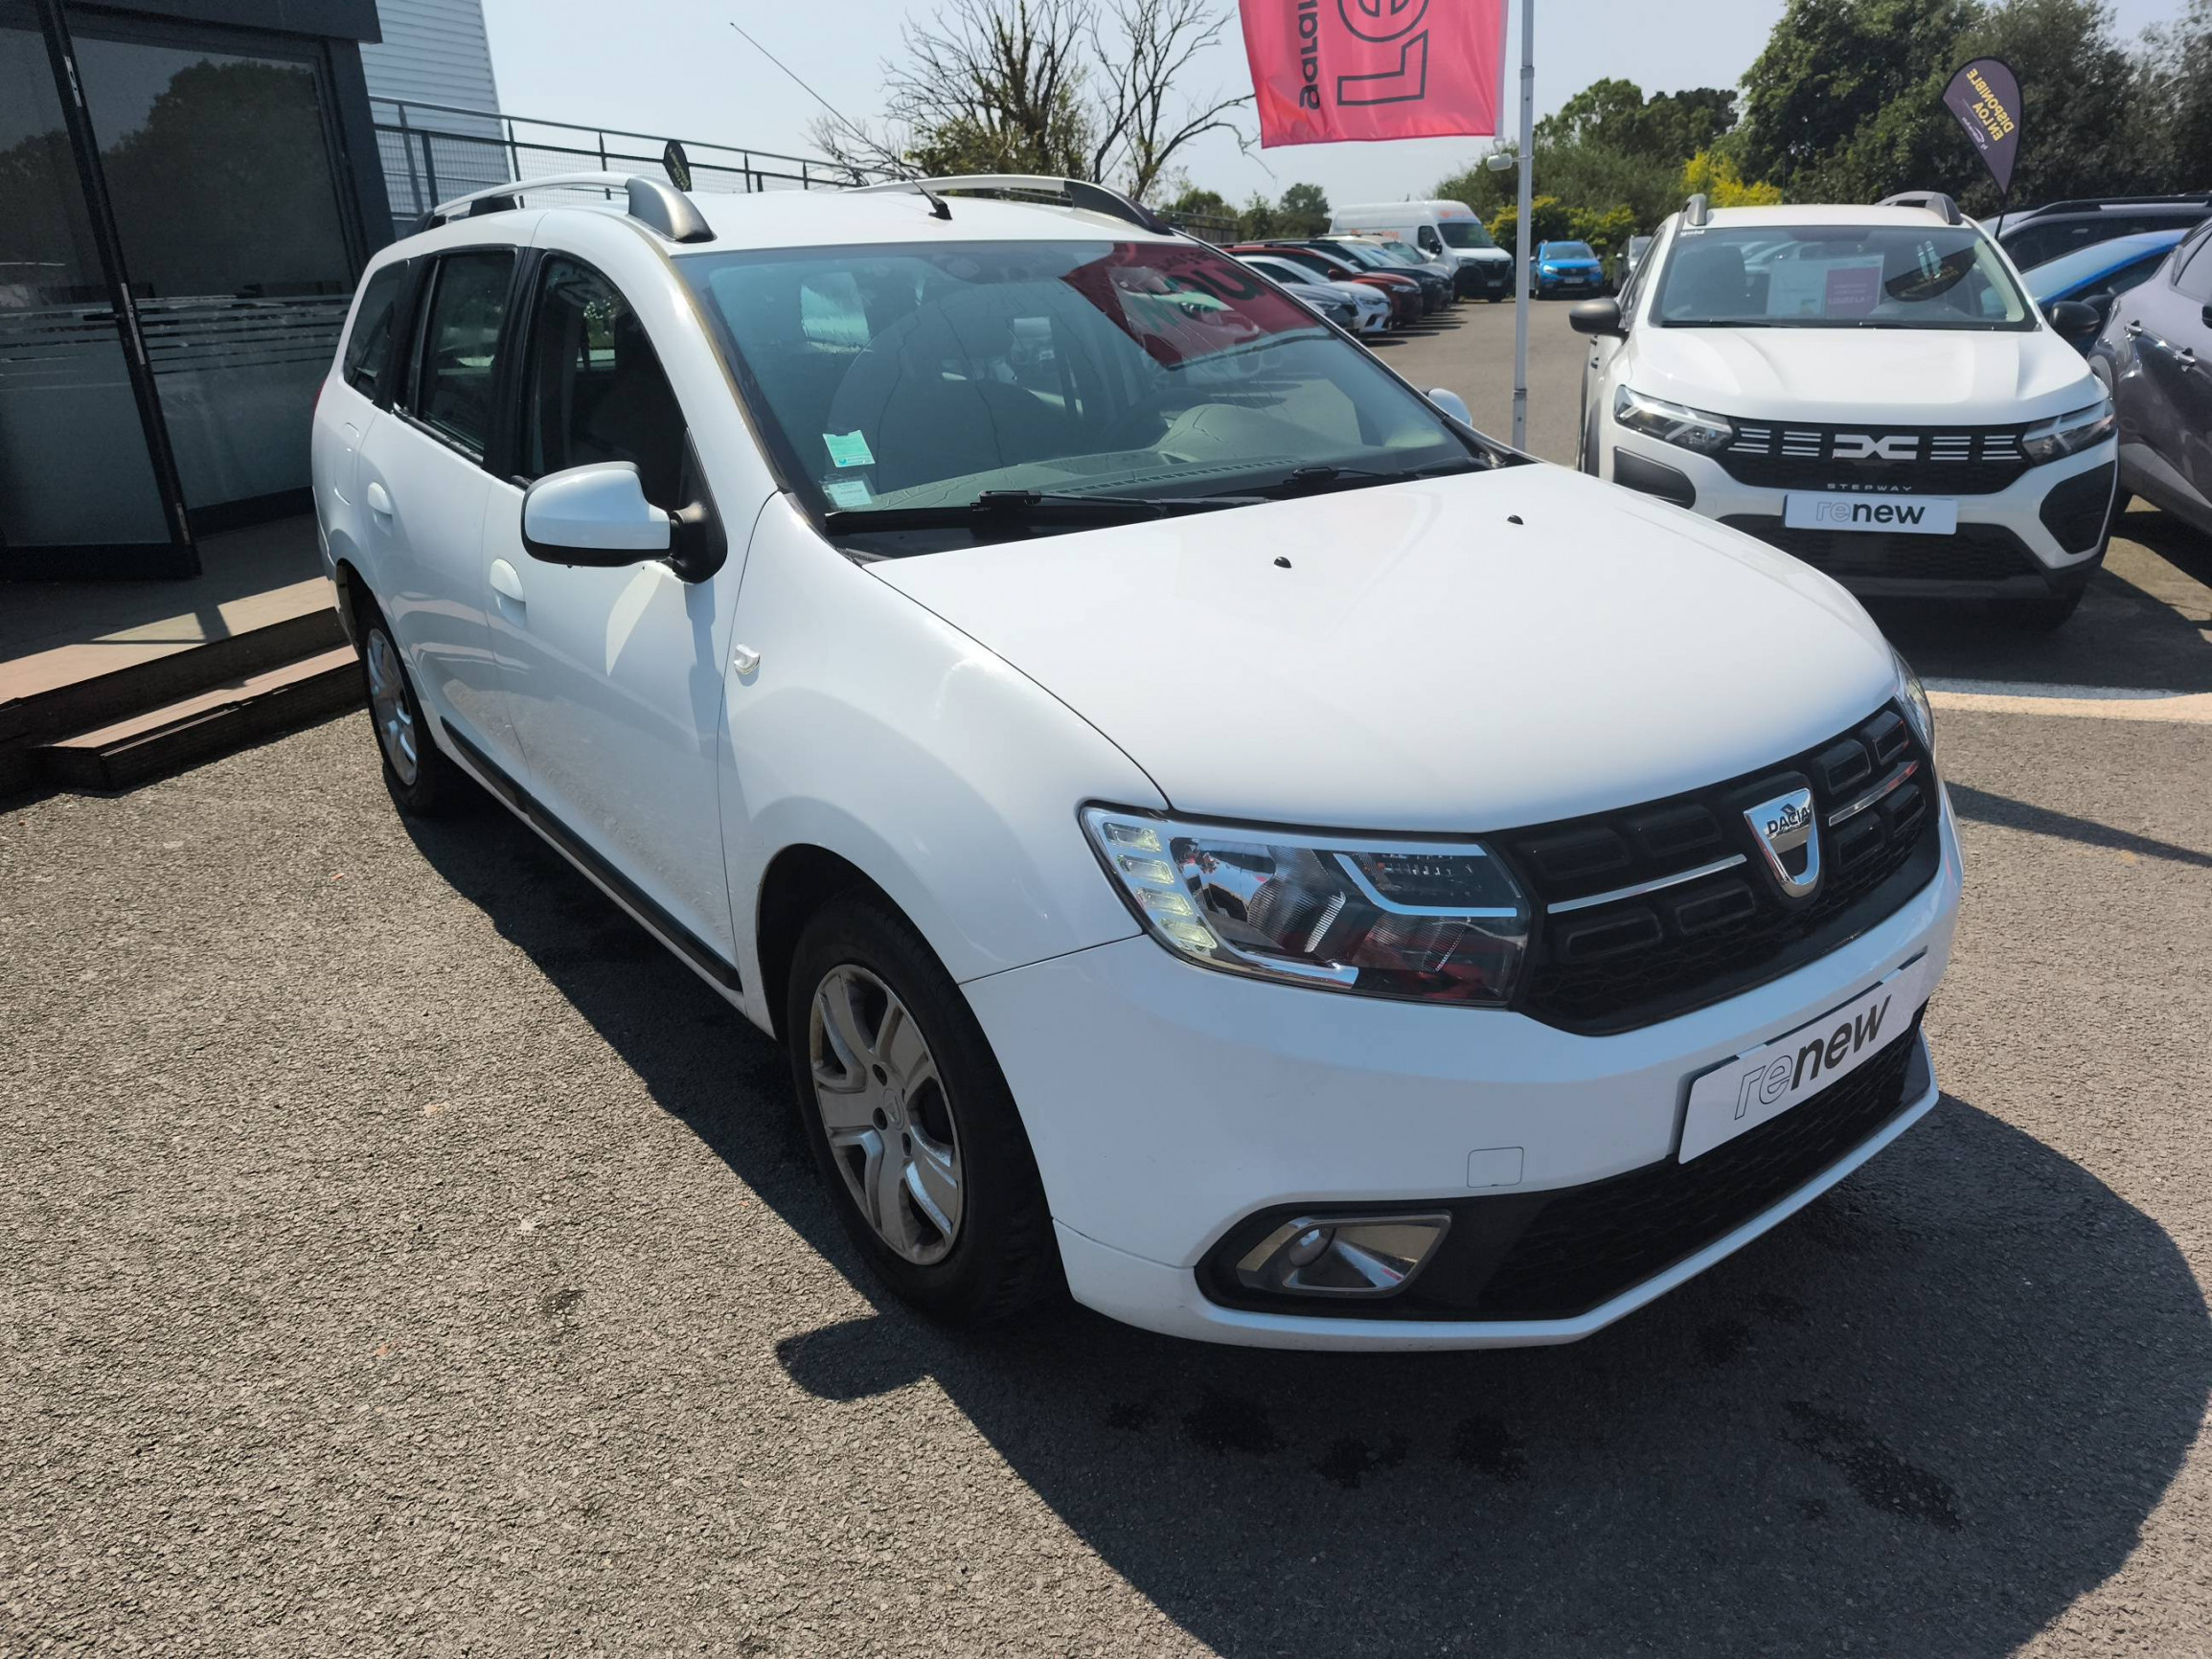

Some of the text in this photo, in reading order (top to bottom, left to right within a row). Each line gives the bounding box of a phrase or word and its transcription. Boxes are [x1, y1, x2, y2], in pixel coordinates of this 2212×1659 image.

[1827, 483, 1912, 491] STEPWAY
[1815, 501, 1926, 525] renew
[1767, 807, 1810, 834] DACIA
[1734, 994, 1892, 1121] renew
